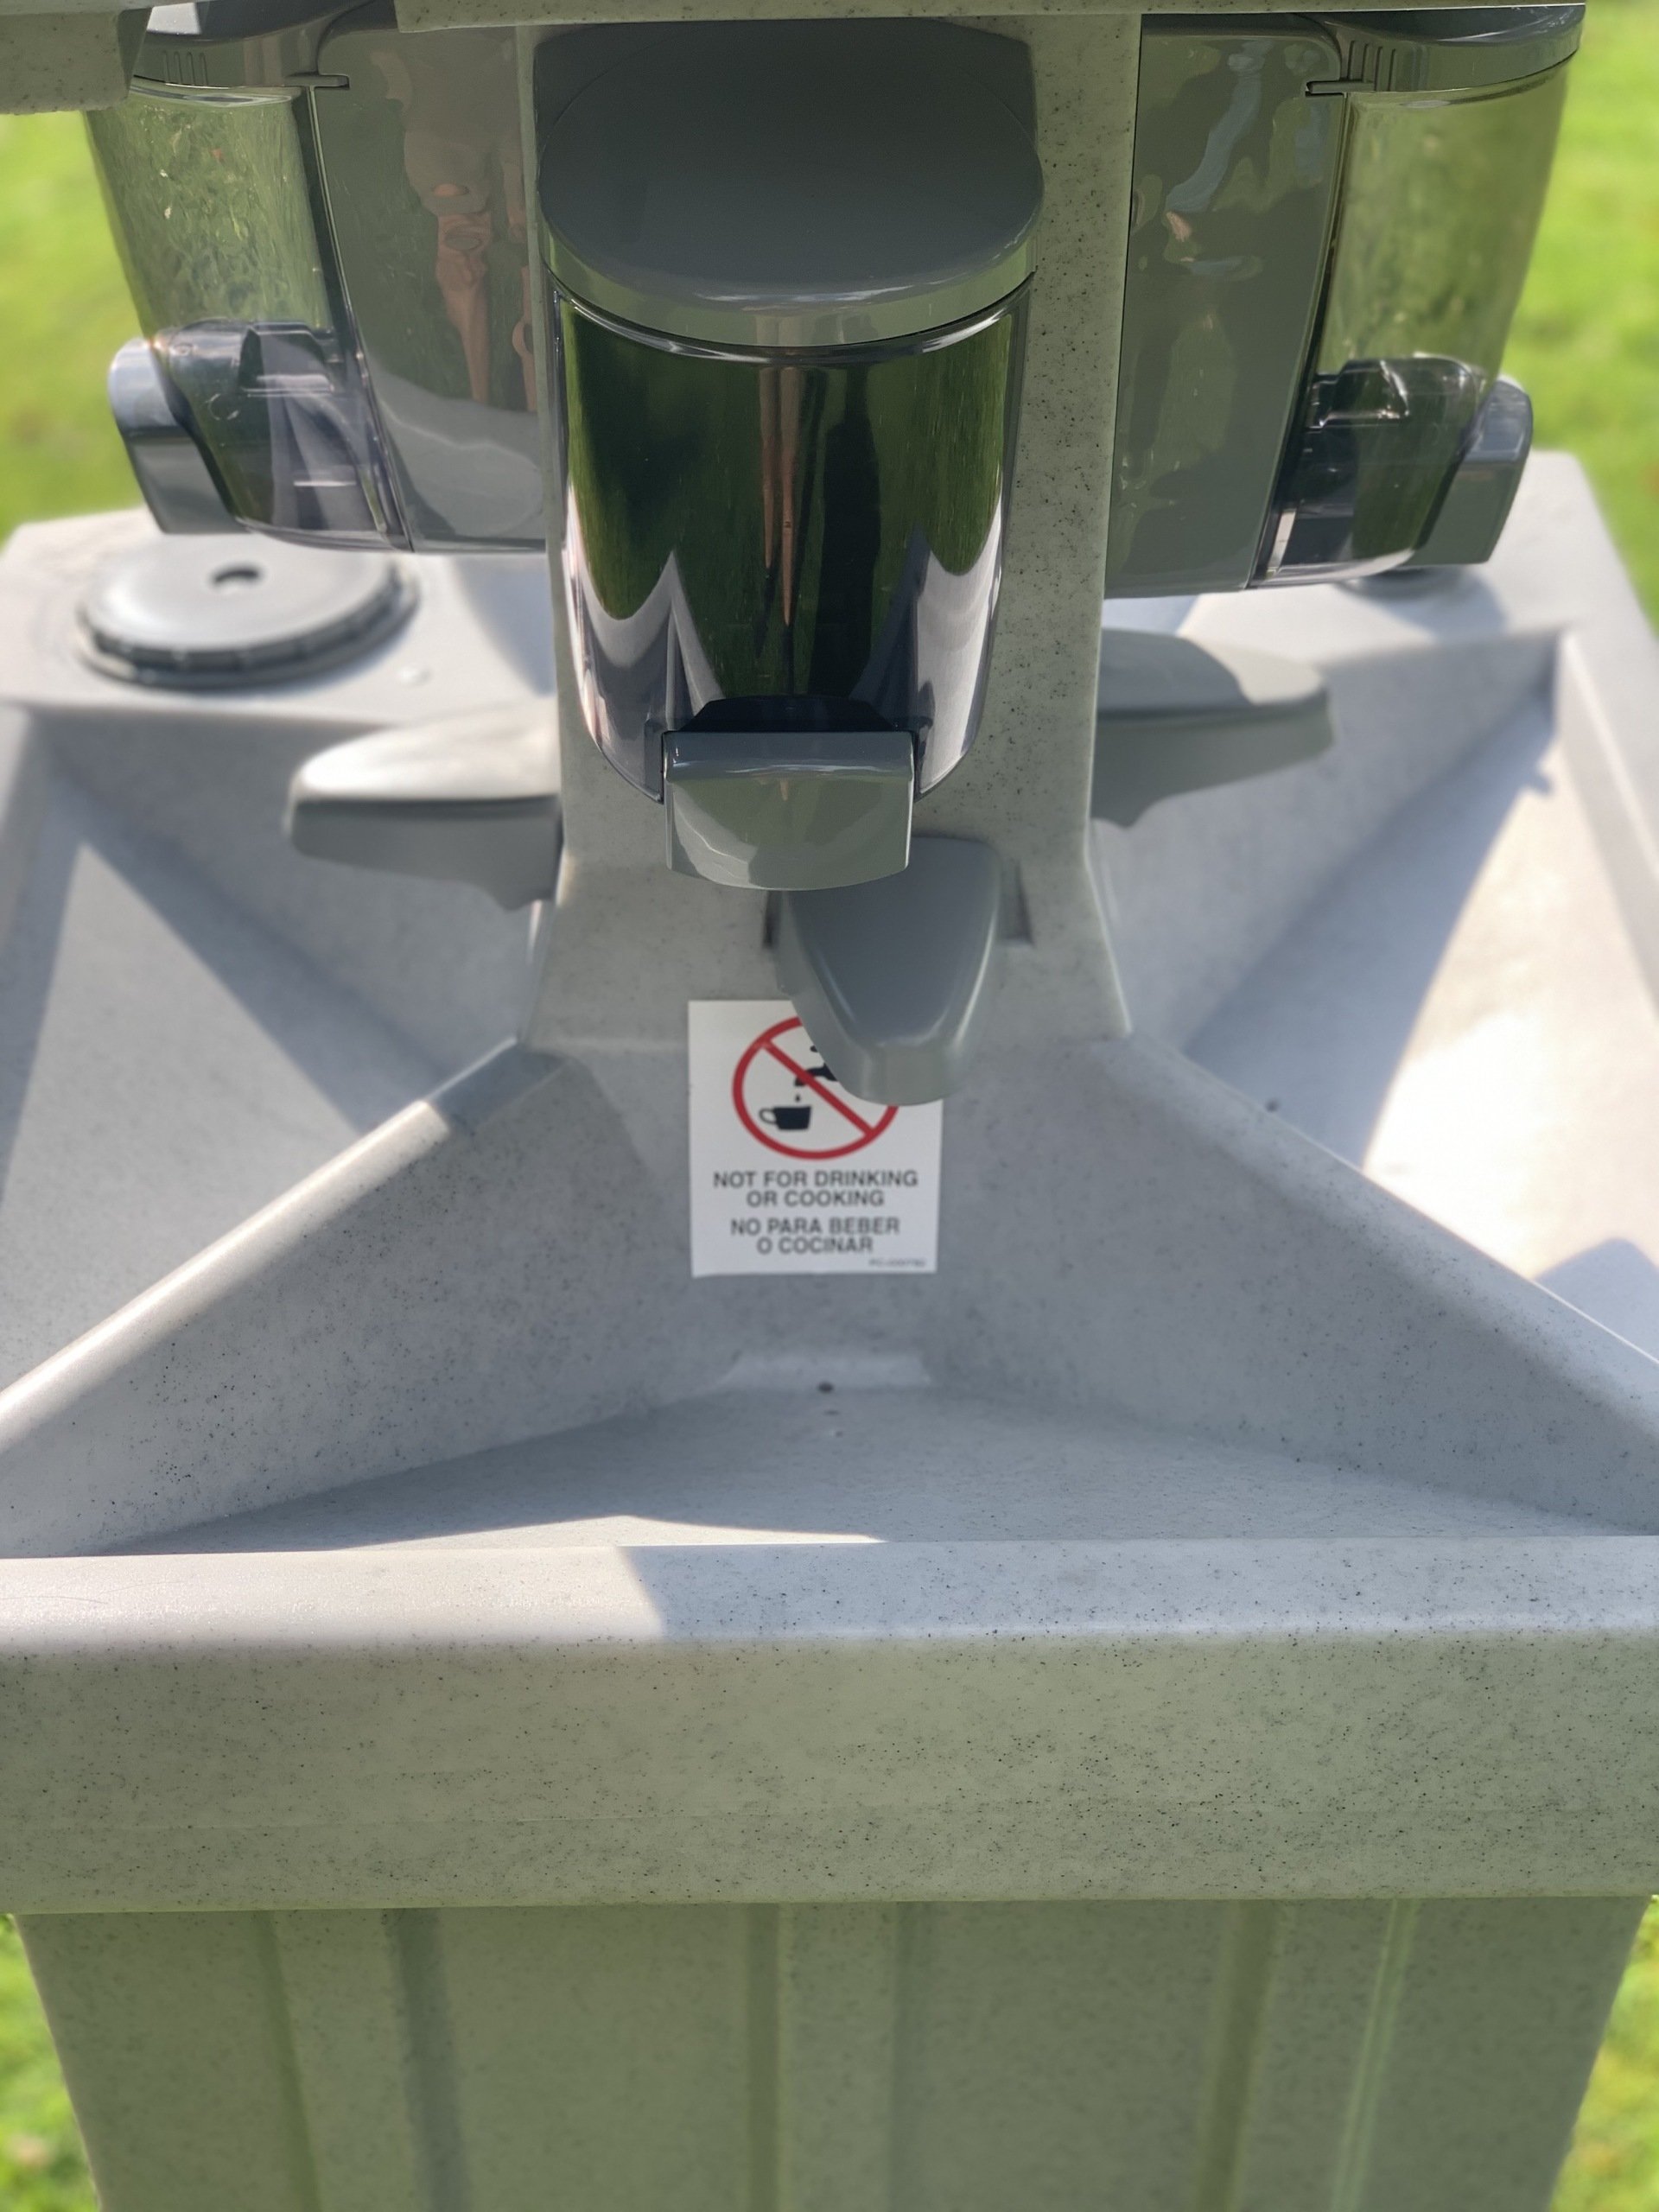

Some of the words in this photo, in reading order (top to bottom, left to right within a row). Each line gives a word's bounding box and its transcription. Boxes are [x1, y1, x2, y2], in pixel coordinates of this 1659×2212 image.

[713, 1171, 757, 1189] NOT
[764, 1170, 808, 1188] FOR
[814, 1170, 918, 1188] DRINKING
[747, 1190, 777, 1208] OR
[784, 1190, 885, 1207] COOKING
[731, 1218, 761, 1236] NO
[767, 1217, 822, 1235] PARA
[829, 1217, 899, 1235] BEBER
[756, 1236, 772, 1255] O
[779, 1236, 874, 1254] COCINAR
